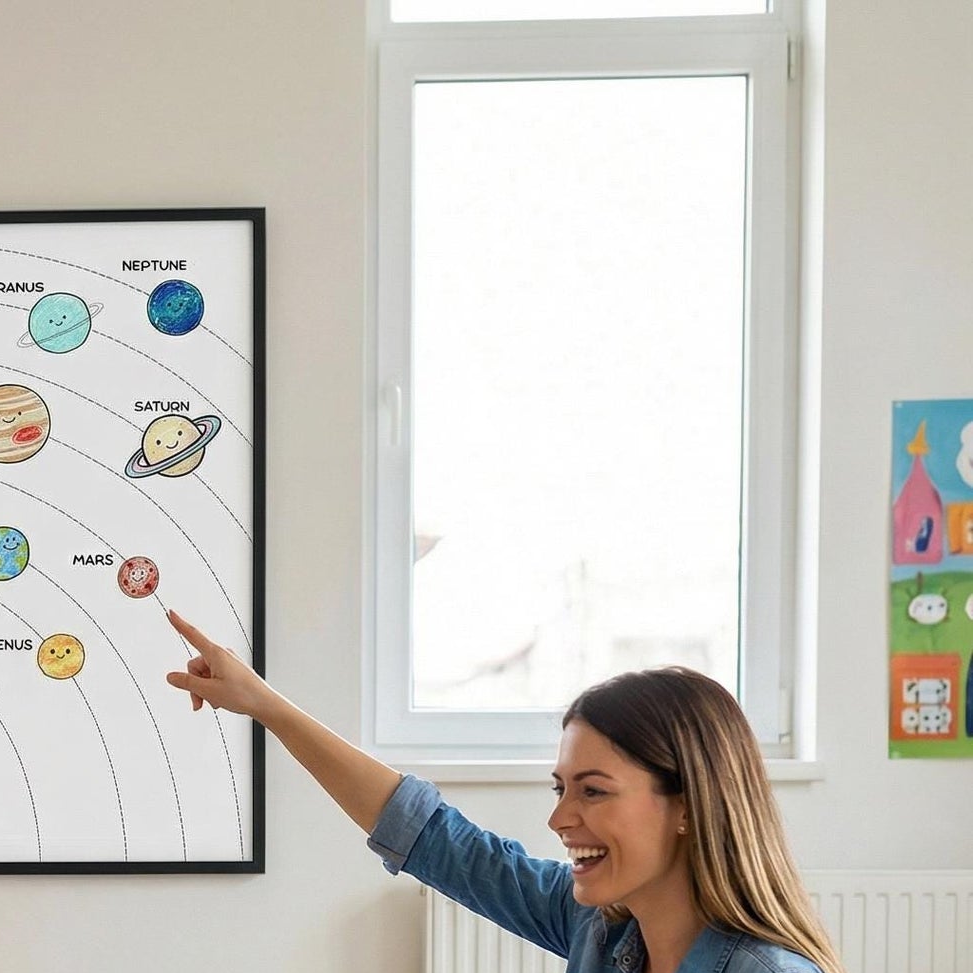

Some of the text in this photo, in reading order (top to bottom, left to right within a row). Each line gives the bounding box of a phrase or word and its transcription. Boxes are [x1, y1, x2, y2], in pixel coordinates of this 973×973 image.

[122, 259, 187, 272] NEPTUNE
[134, 400, 190, 413] SATURN
[72, 554, 115, 566] MARS
